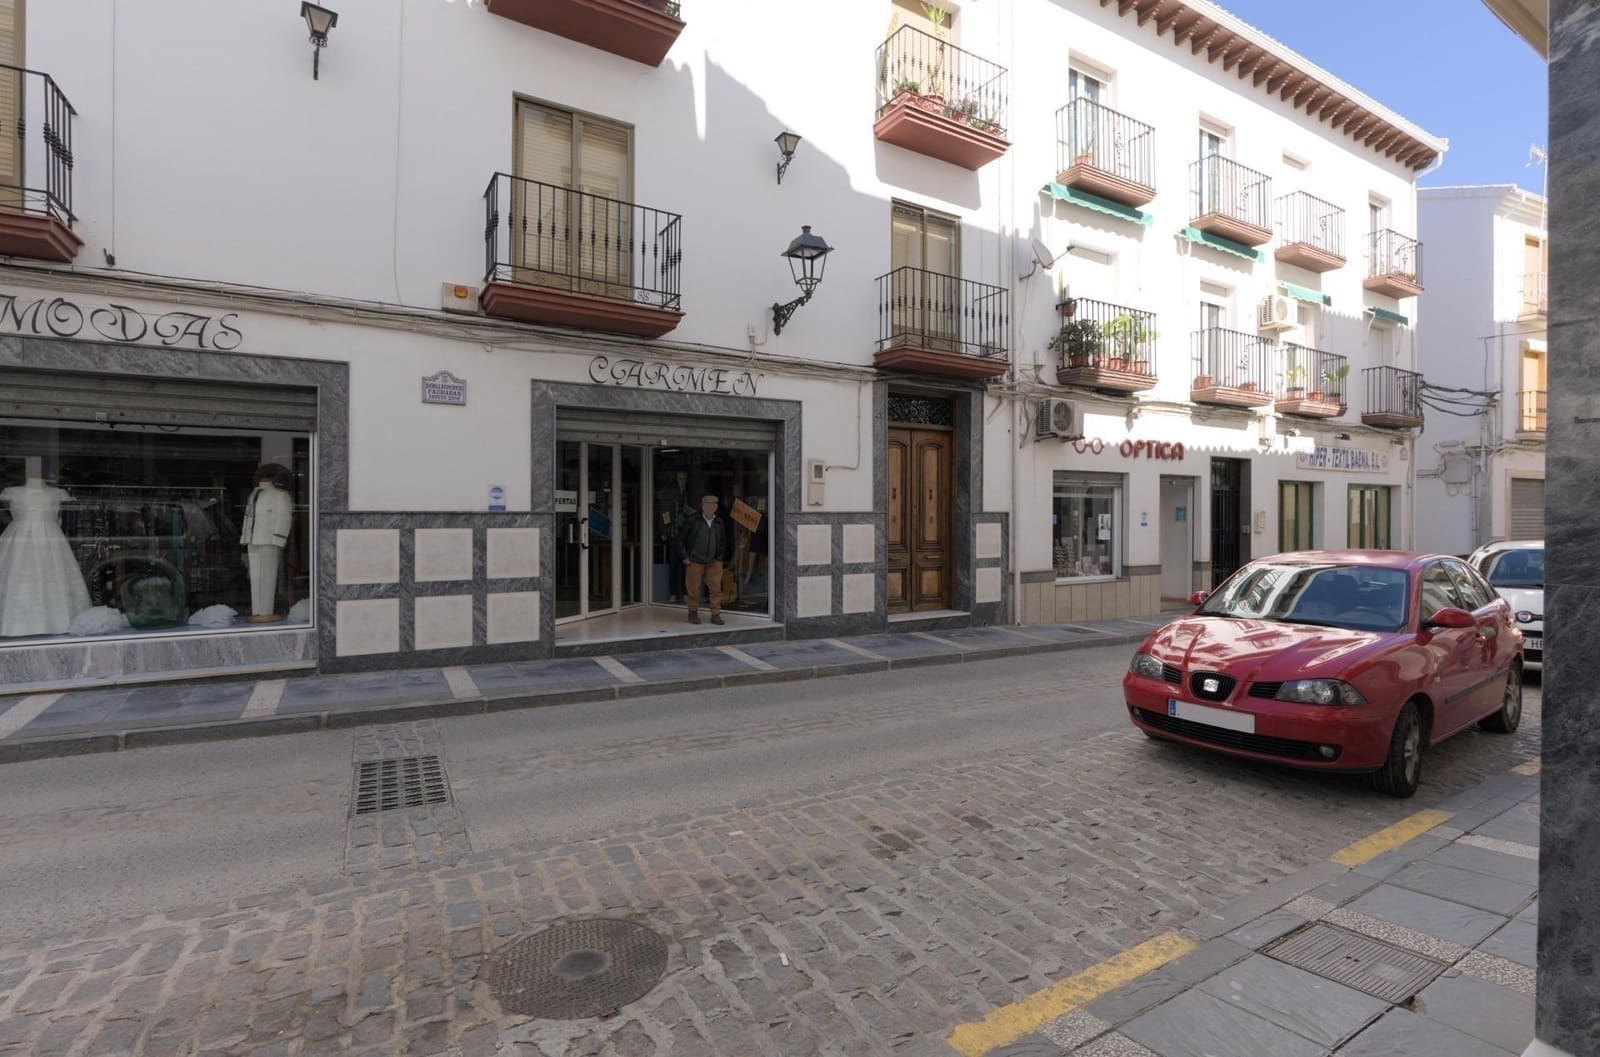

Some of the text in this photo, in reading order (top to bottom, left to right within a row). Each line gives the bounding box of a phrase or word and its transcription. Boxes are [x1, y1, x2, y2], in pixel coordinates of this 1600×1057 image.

[0, 295, 243, 350] MODAS
[588, 355, 765, 396] CARMEN
[1120, 439, 1184, 461] OPTICA
